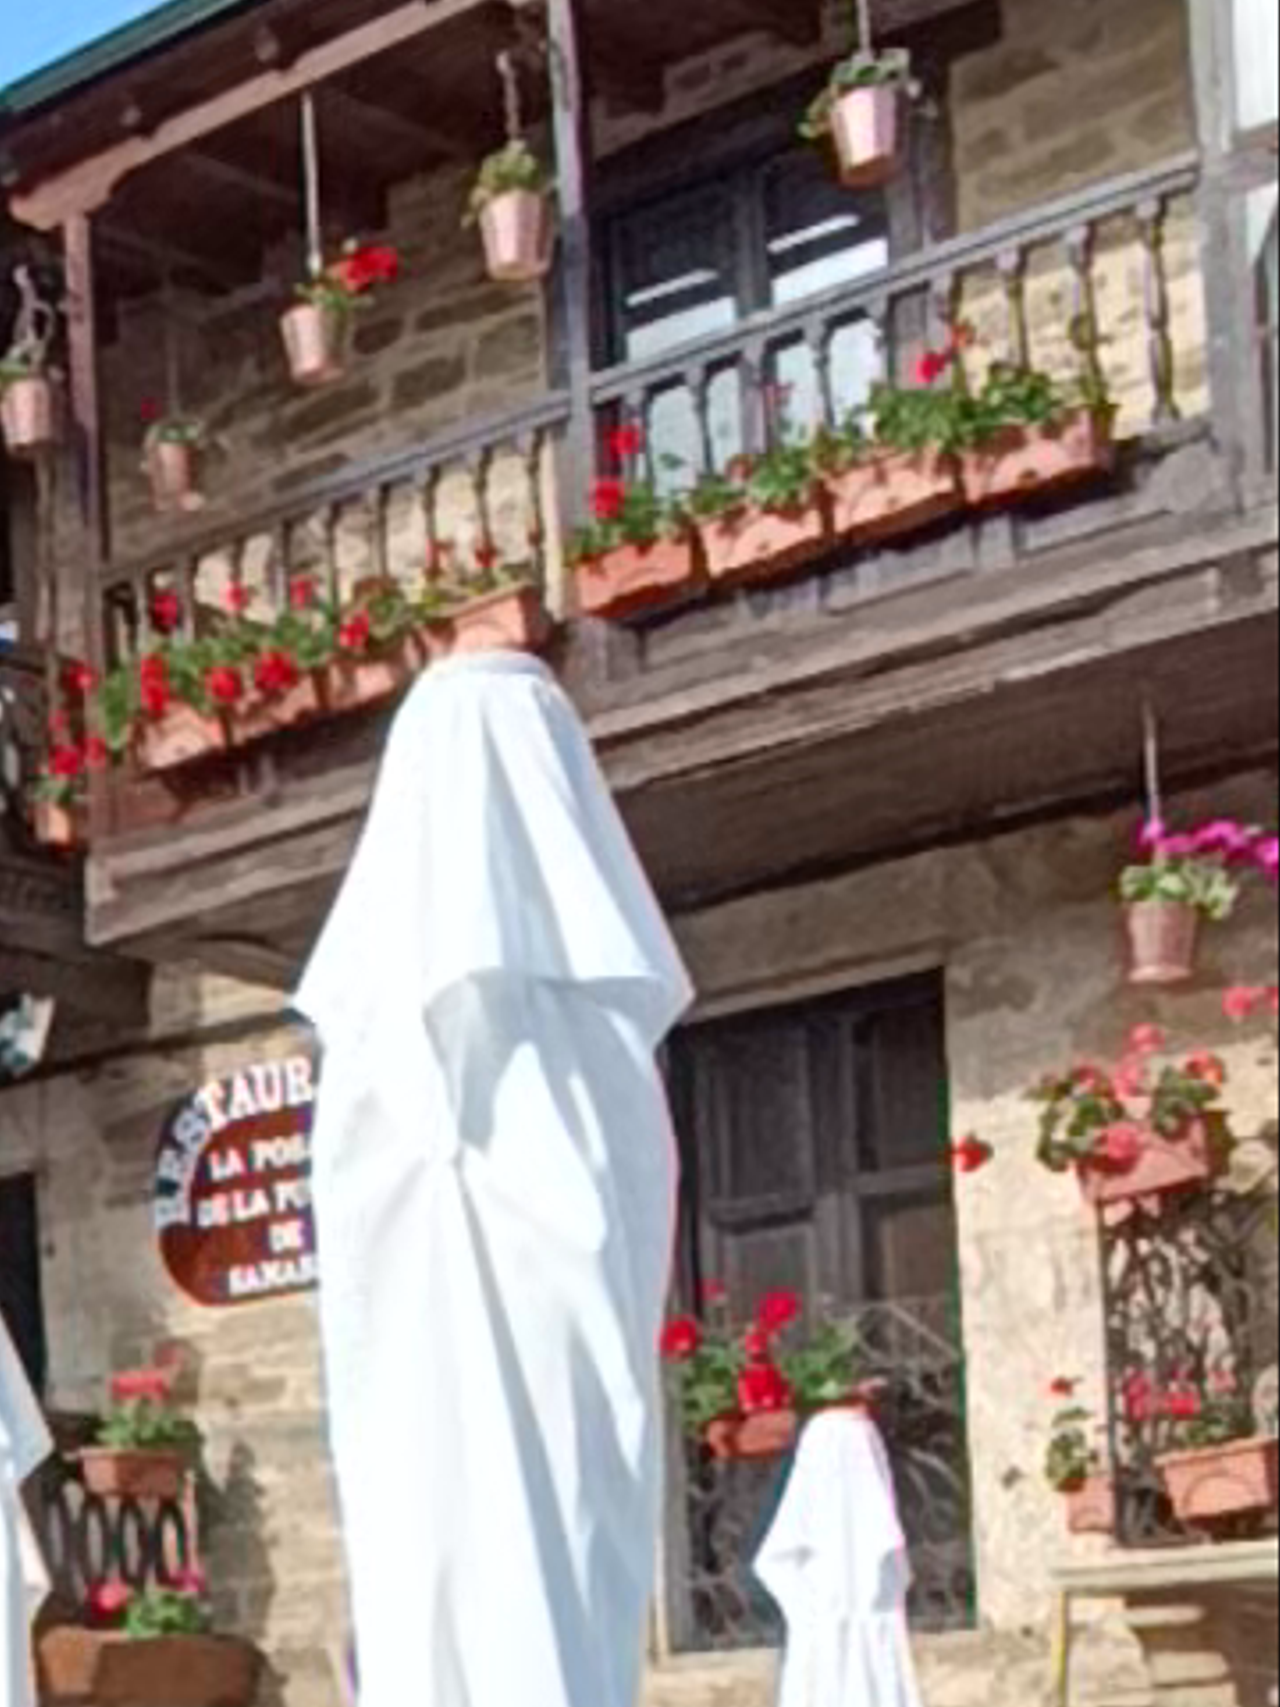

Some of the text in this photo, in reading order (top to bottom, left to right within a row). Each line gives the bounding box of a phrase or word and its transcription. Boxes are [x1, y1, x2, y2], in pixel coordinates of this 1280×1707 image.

[154, 1056, 312, 1228] RESTAUR
[209, 1133, 311, 1181] LA POS
[232, 1188, 270, 1221] LA
[269, 1220, 304, 1252] DE
